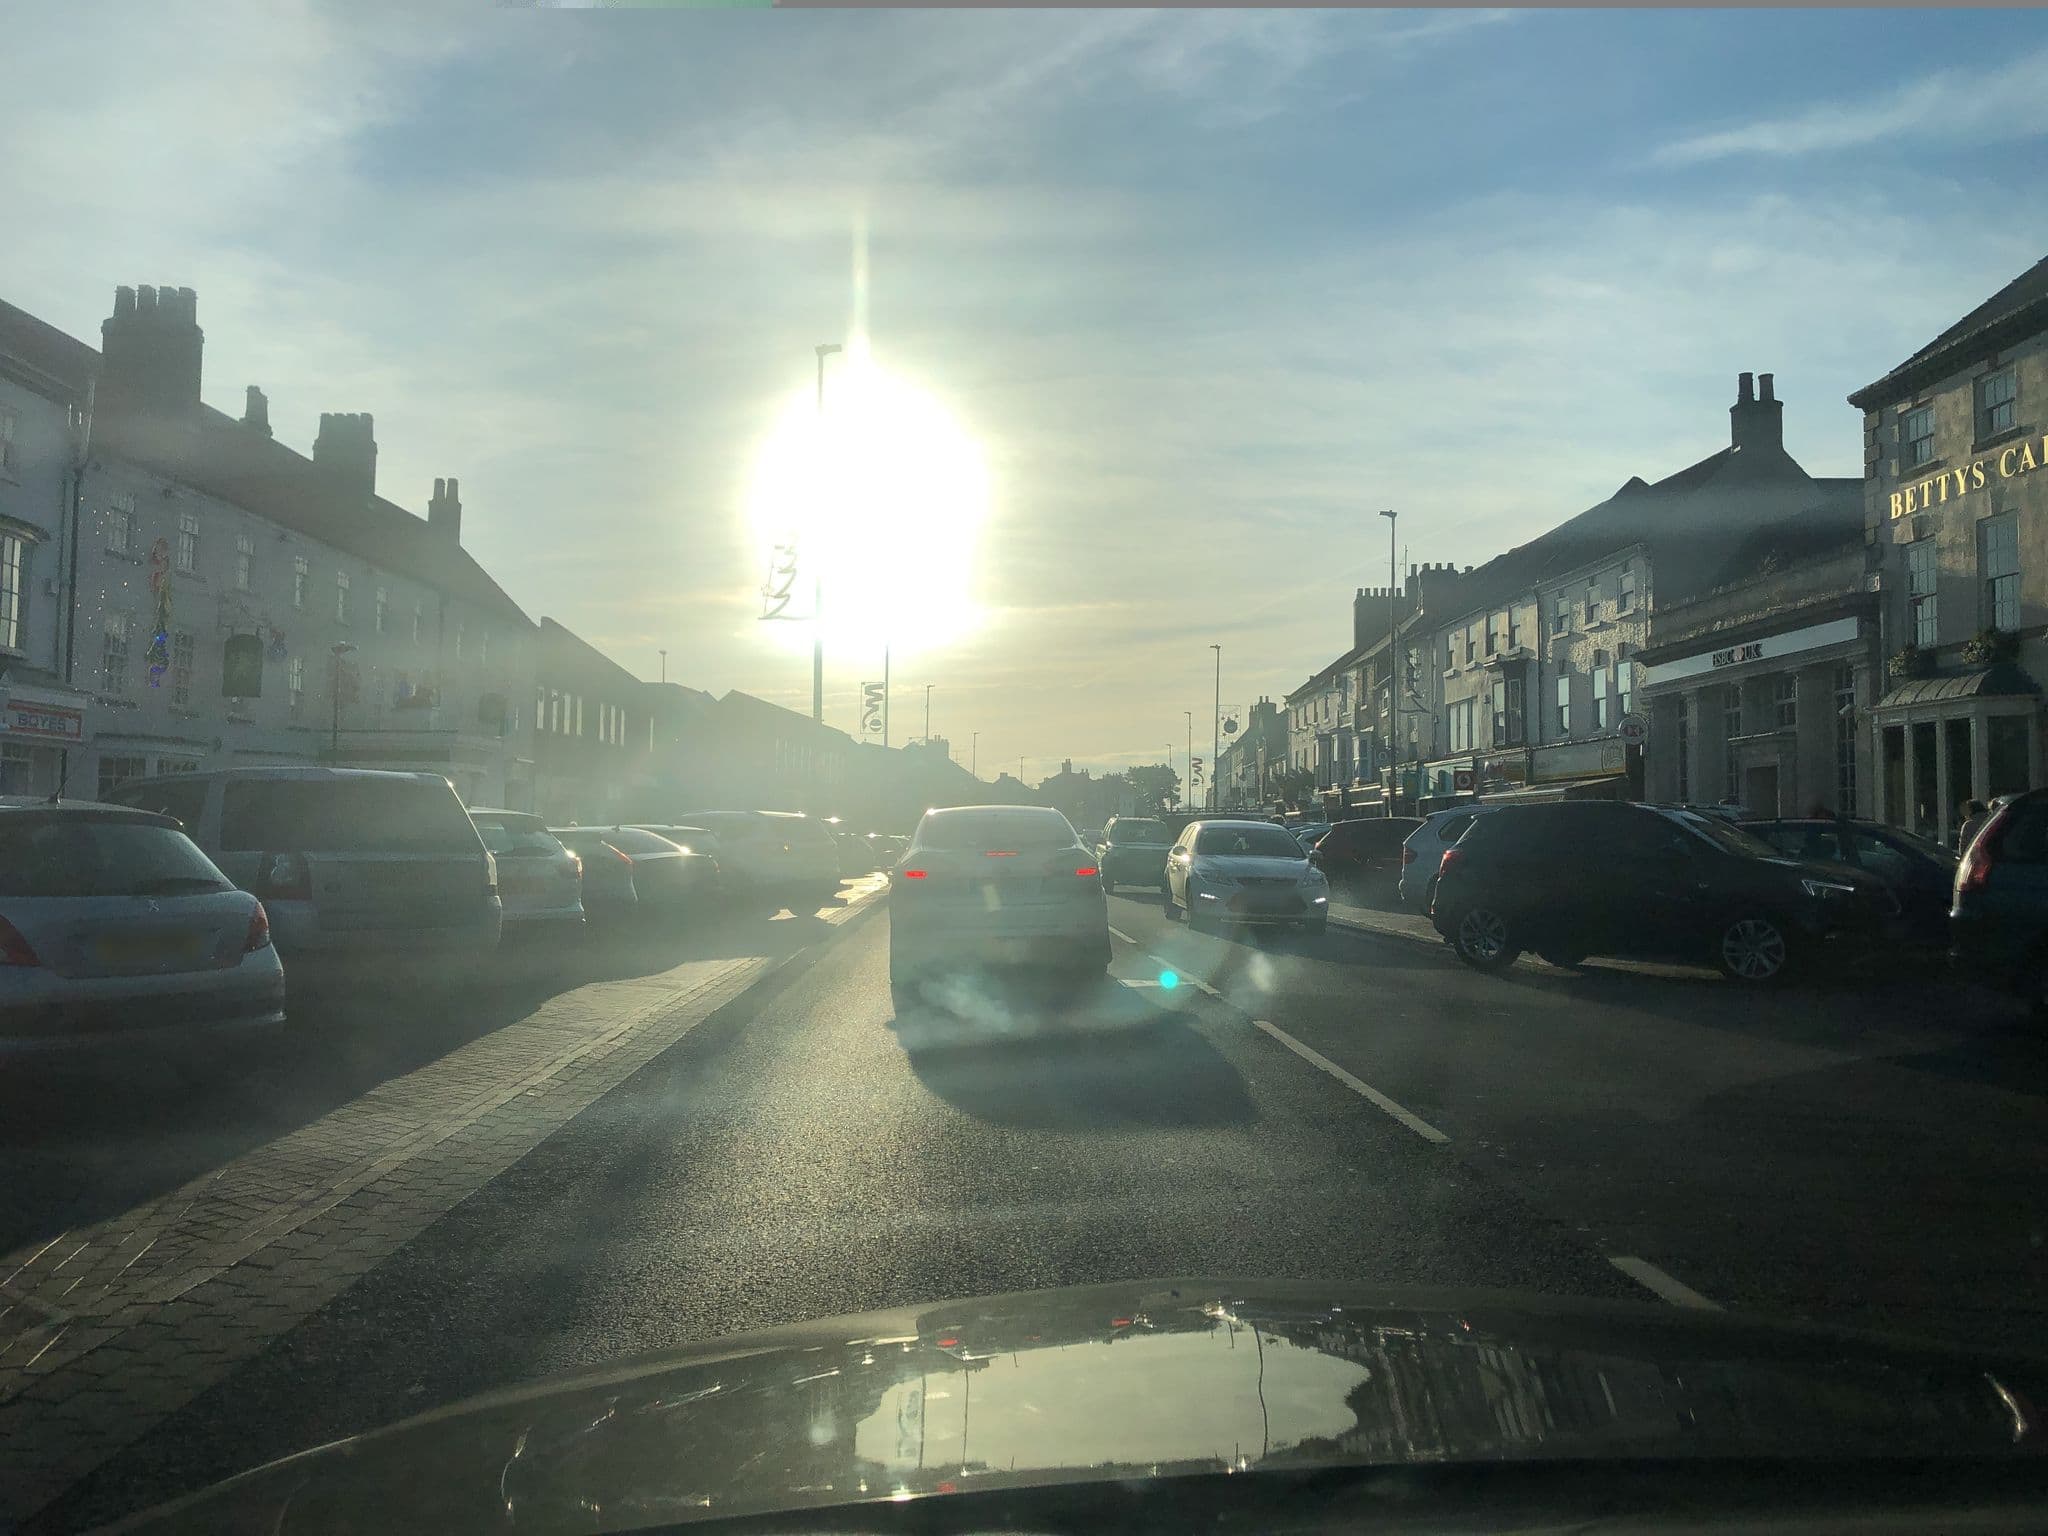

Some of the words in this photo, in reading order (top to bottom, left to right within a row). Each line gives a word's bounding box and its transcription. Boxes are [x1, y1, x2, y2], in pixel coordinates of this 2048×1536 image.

[1889, 460, 1985, 520] BETTYS
[1744, 643, 1763, 660] UK
[16, 712, 66, 732] BOYES
